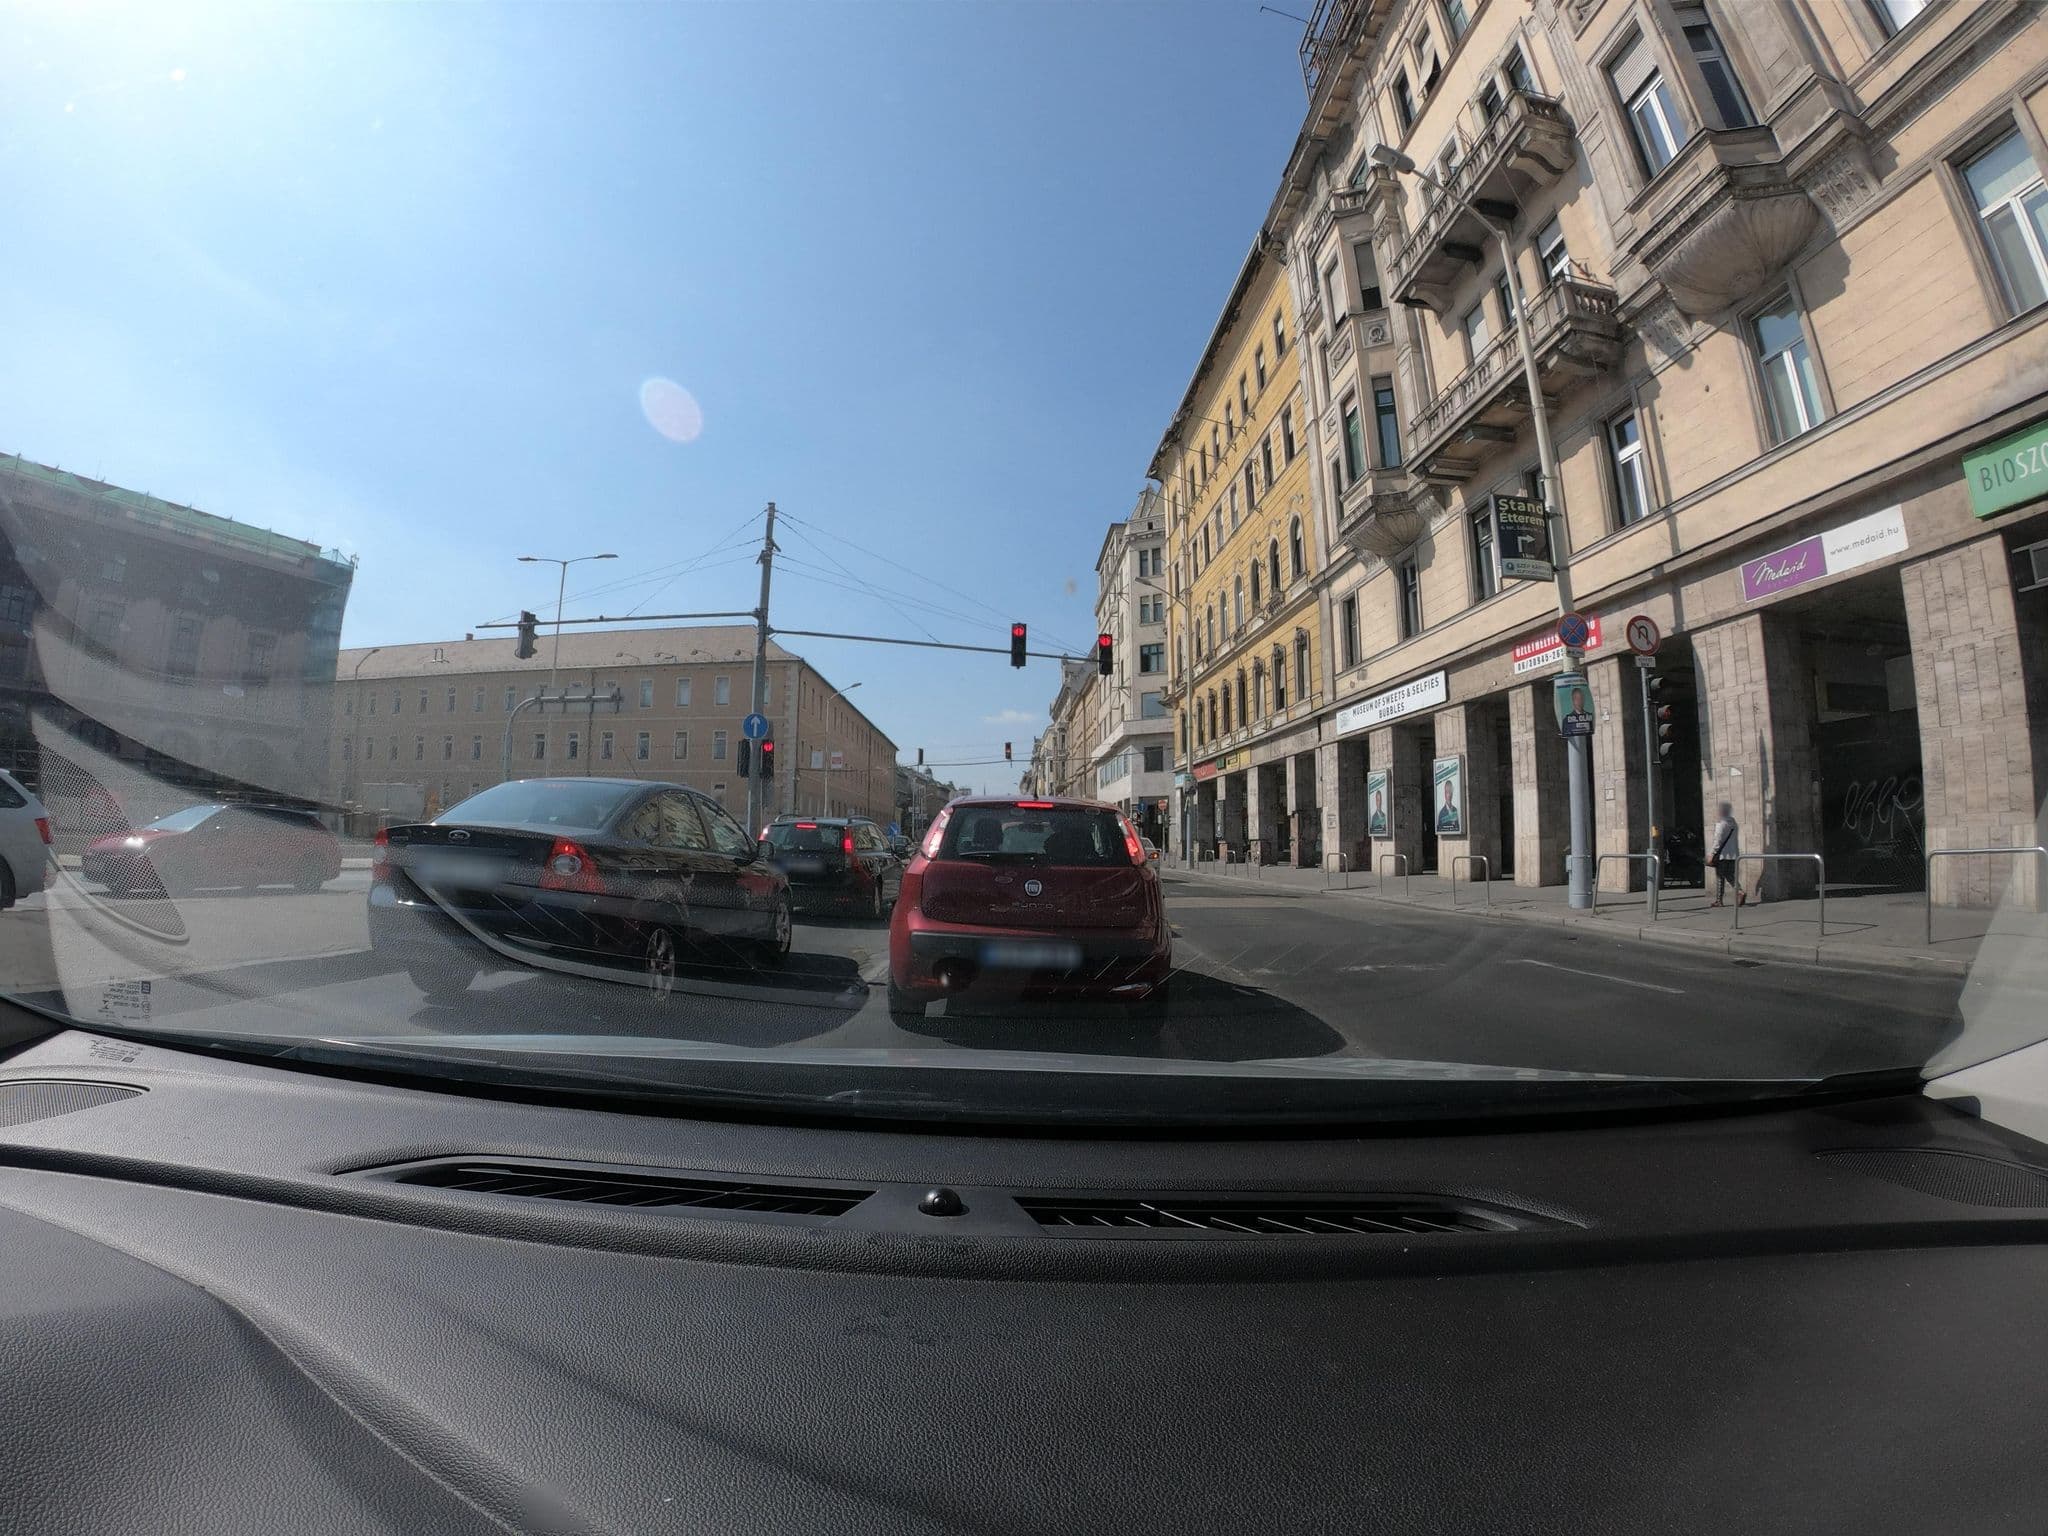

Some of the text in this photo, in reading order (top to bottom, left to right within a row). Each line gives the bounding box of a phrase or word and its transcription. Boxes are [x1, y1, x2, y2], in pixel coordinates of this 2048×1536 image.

[1498, 498, 1543, 515] Stand
[1499, 510, 1545, 528] Étterem
[1515, 633, 1560, 657] ÜZLETHELYIS
[1352, 702, 1374, 717] MUSEUM
[1374, 698, 1382, 710] OF
[1382, 689, 1406, 706] SWEETS
[1411, 676, 1440, 696] SELFIES
[1378, 701, 1405, 719] BUBBLES
